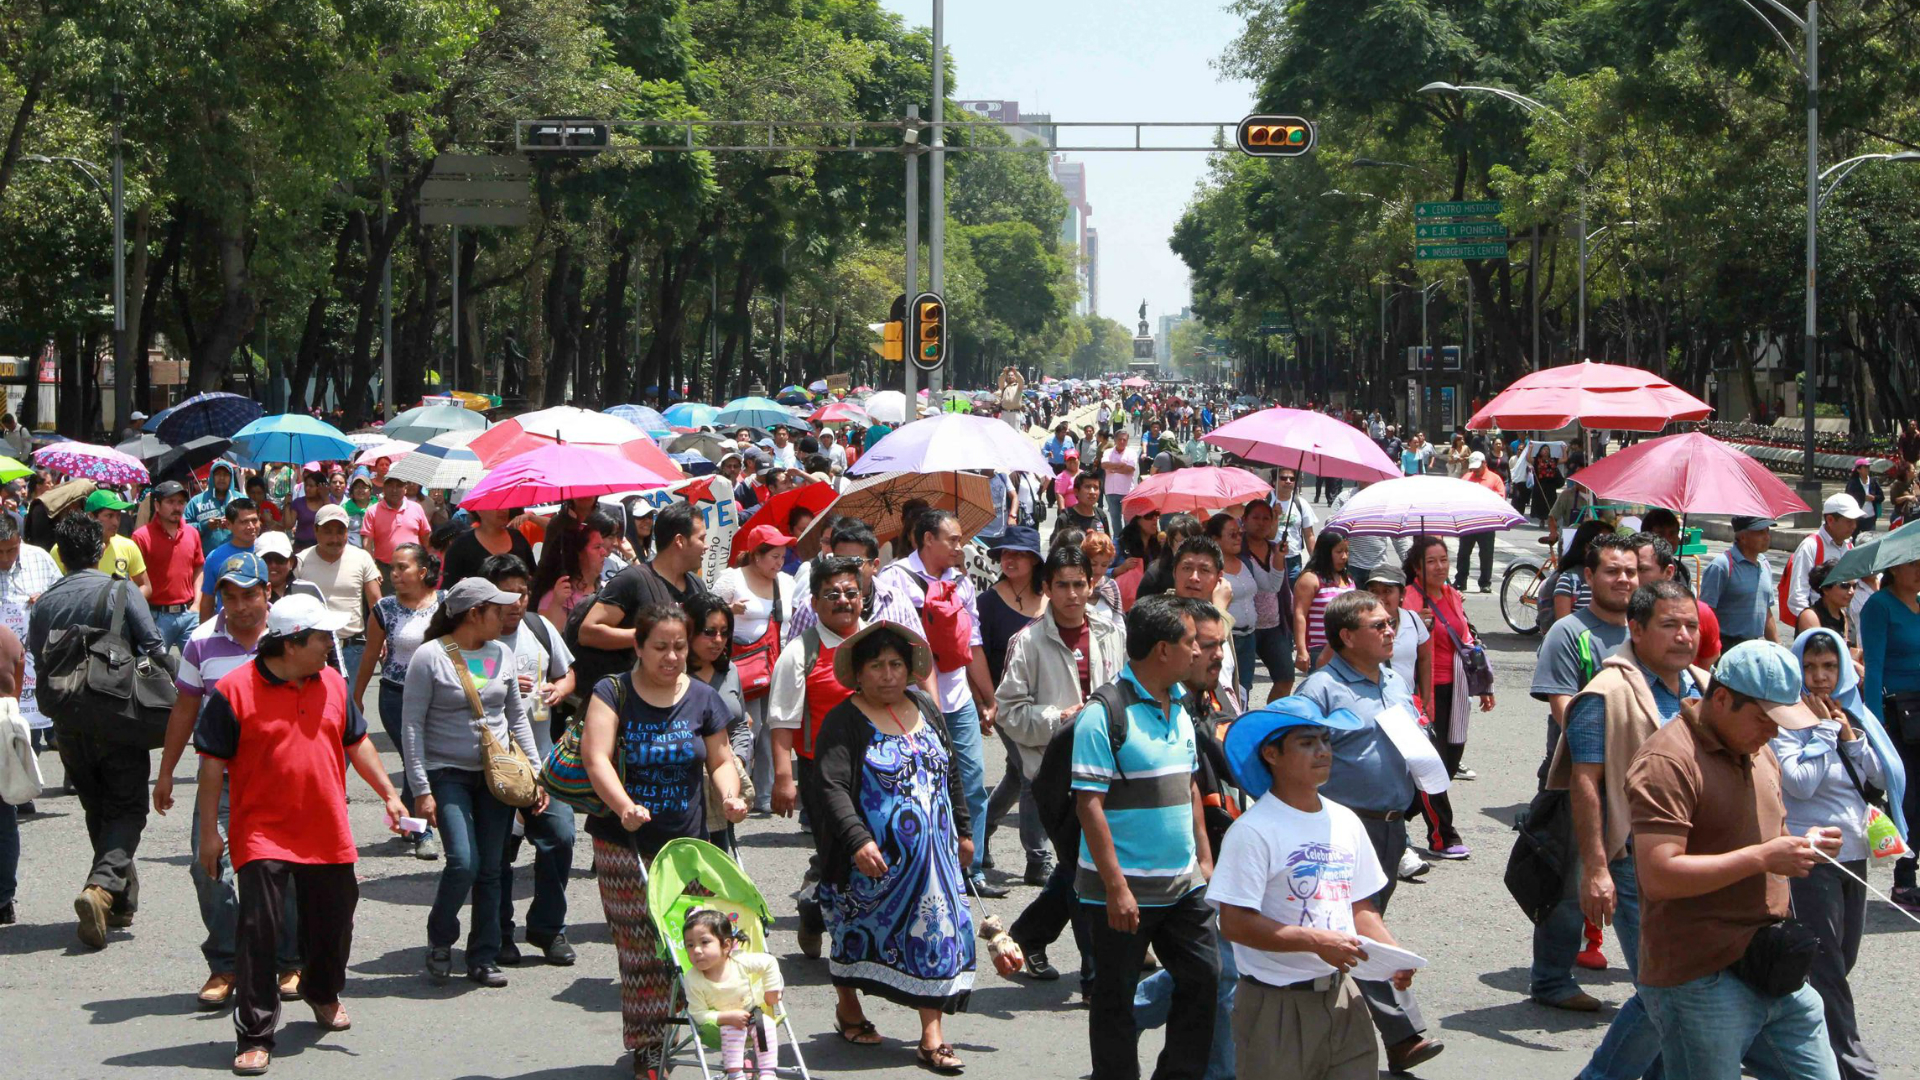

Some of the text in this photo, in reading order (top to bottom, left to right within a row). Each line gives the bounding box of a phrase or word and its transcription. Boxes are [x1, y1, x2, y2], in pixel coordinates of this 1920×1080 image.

[1431, 205, 1461, 214] CENTRO
[1432, 226, 1448, 236] EJE
[1460, 225, 1504, 235] PONIENTE
[1432, 246, 1505, 257] INSURGENTES CENTRO
[196, 499, 216, 512] York
[626, 720, 690, 731] I LOVE MY
[651, 730, 694, 742] FRIENDS
[626, 741, 695, 764] GIRLS
[660, 784, 689, 798] HAVE
